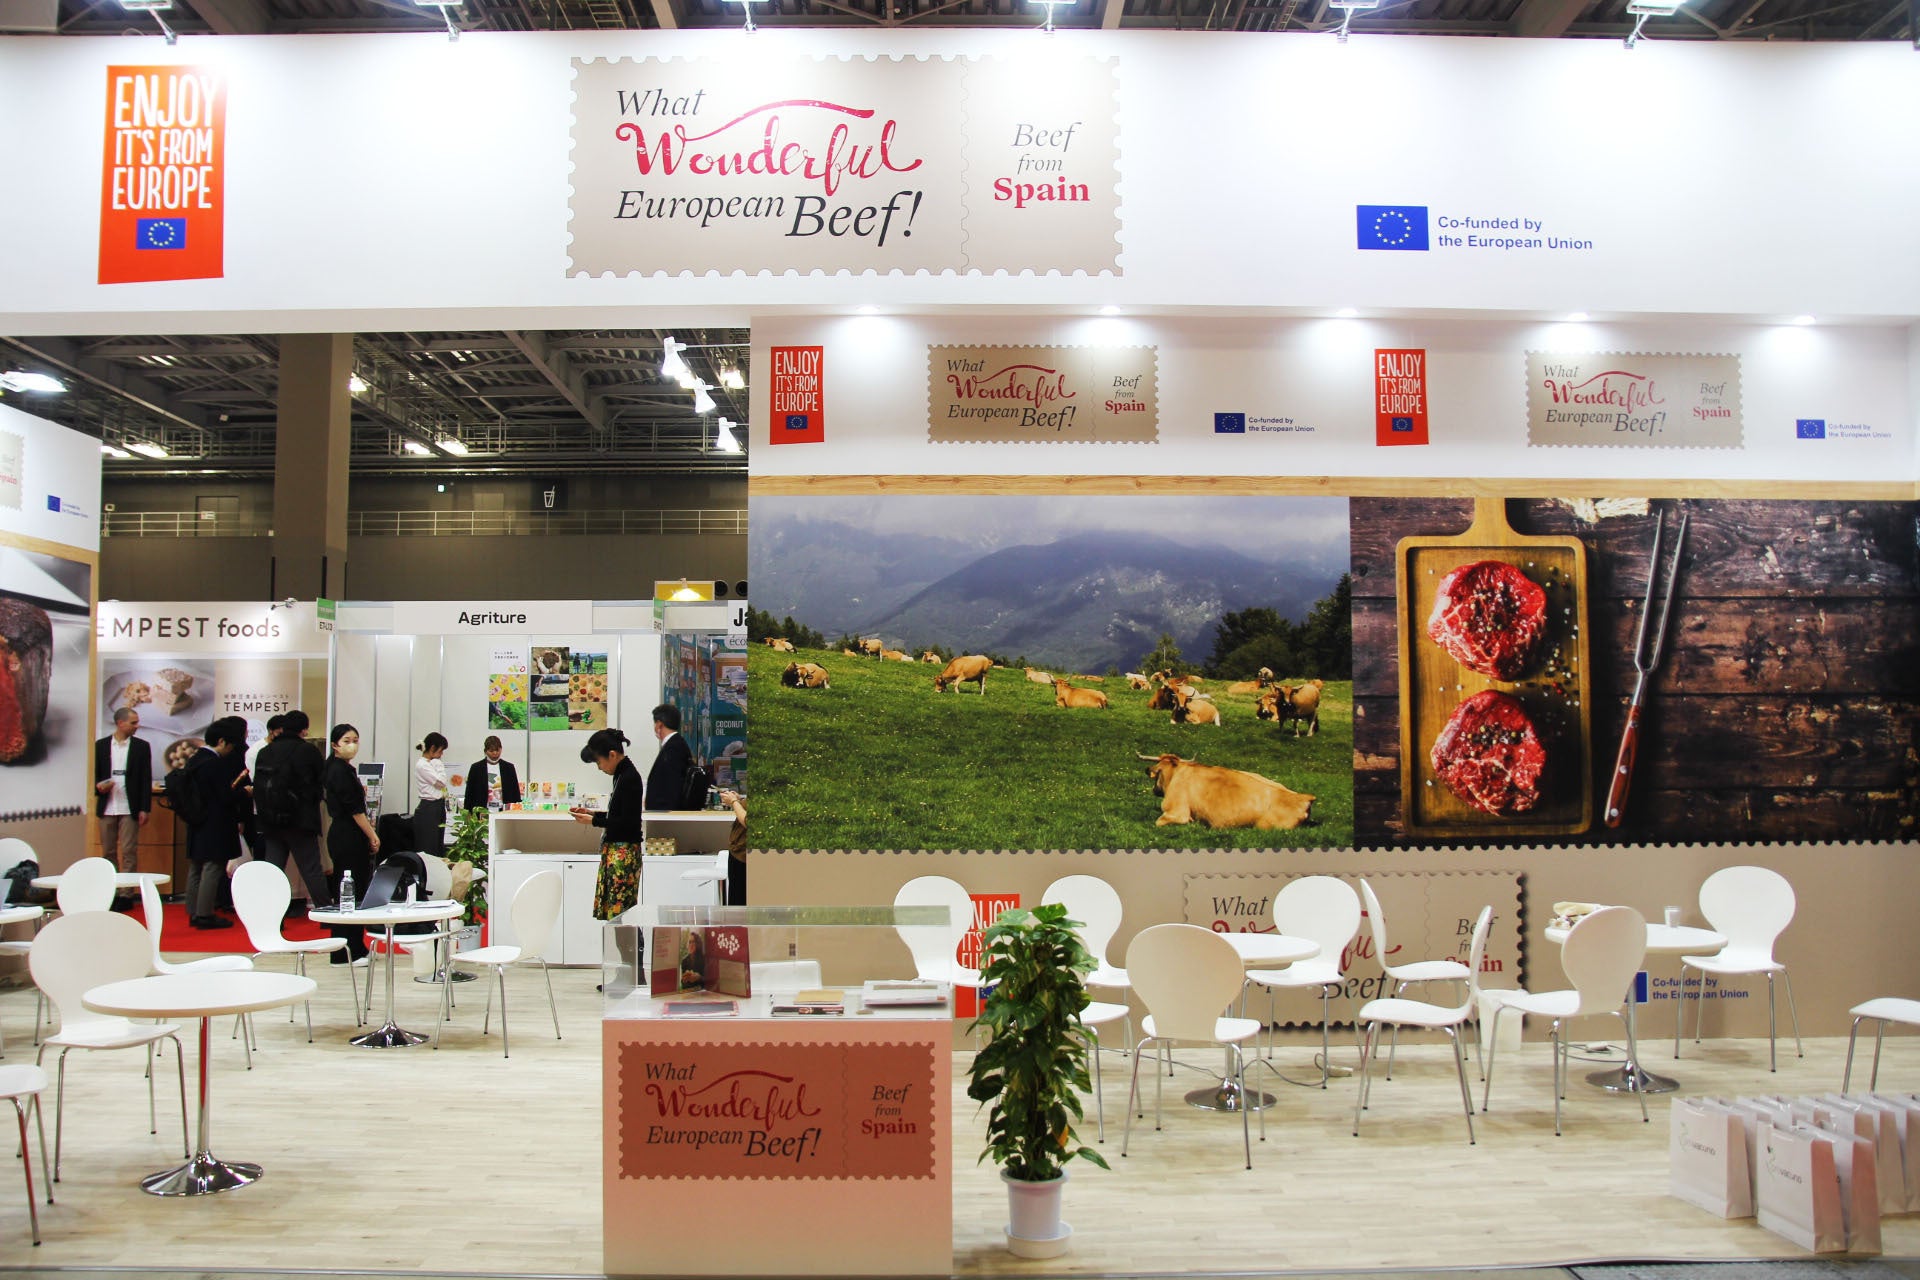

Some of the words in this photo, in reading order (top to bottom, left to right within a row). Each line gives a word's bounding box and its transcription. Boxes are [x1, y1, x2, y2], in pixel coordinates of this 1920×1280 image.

[113, 74, 218, 128] ENJOY
[615, 88, 707, 117] What
[115, 128, 155, 165] IT'S
[159, 128, 213, 165] FROM
[1011, 121, 1083, 154] Beef
[615, 99, 923, 197] Wonderful
[1017, 153, 1064, 175] from
[111, 165, 213, 210] EUROPE
[993, 176, 1091, 209] Spain
[613, 190, 786, 227] European
[785, 190, 923, 248] Beef!
[1437, 216, 1520, 230] Co-funded
[1524, 217, 1543, 233] by
[1437, 235, 1463, 248] the
[1467, 235, 1543, 251] European
[1547, 236, 1594, 250] Union
[774, 350, 819, 375] ENJOY
[946, 358, 986, 373] What
[1378, 353, 1422, 377] ENJOY
[1543, 364, 1580, 379] What
[775, 375, 793, 392] IT'S
[794, 374, 818, 392] FROM
[946, 364, 1077, 408] Wonderful
[1112, 374, 1143, 389] Beef
[1379, 377, 1397, 394] IT'S
[1398, 378, 1421, 394] FROM
[1700, 381, 1728, 396] Beef
[774, 391, 819, 412] EUROPE
[1114, 388, 1135, 401] from
[1543, 370, 1665, 414] Wonderful
[1104, 399, 1146, 414] Spain
[1380, 394, 1423, 414] EUROPE
[1692, 405, 1732, 420] Spain
[946, 404, 1020, 423] European
[1018, 405, 1077, 432] Beef!
[1248, 416, 1284, 424] Co-funded
[1285, 416, 1294, 425] by
[1545, 408, 1613, 428] European
[1613, 411, 1668, 437] Beef!
[1261, 425, 1294, 433] European
[217, 617, 280, 638] foods
[458, 611, 527, 626] Agriture
[224, 701, 289, 712] TEMPEST
[715, 720, 744, 729] COCONUT
[715, 728, 726, 736] OIL
[1212, 895, 1269, 916] What
[1705, 977, 1718, 988] by
[1652, 990, 1668, 999] the
[1719, 989, 1749, 999] Union
[645, 1063, 697, 1081] What
[645, 1070, 822, 1132] Wonderful
[872, 1083, 912, 1104] Beef
[874, 1104, 902, 1118] from
[861, 1117, 918, 1138] Spain
[645, 1125, 743, 1150] European
[743, 1127, 822, 1163] Beef!
